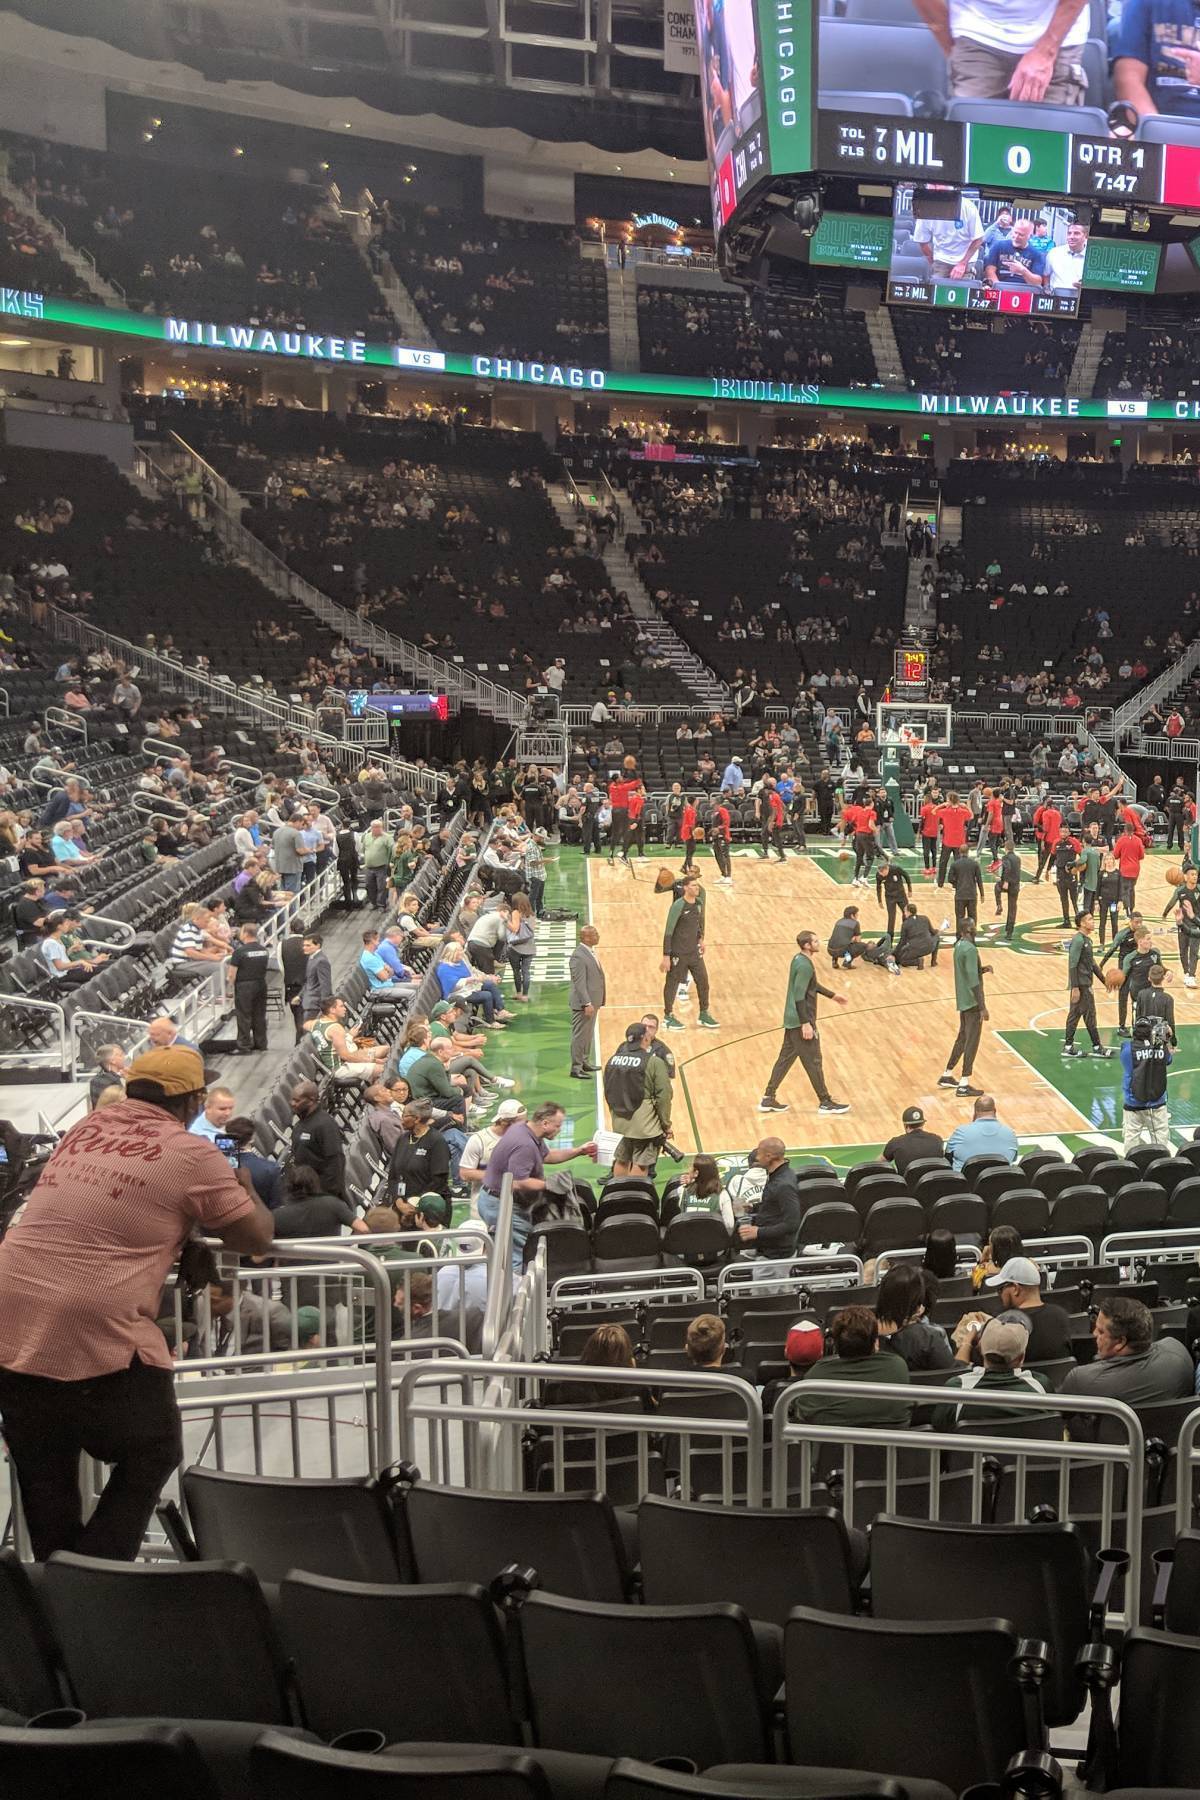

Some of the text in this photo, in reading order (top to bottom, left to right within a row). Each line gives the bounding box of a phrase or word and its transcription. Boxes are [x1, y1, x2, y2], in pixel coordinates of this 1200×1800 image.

[841, 127, 887, 143] TOL 7
[841, 146, 887, 161] FLS 0
[896, 130, 944, 168] MIL
[1079, 143, 1145, 169] QTR 1
[1007, 146, 1032, 174] 0
[736, 150, 748, 189] CHI
[1094, 172, 1138, 193] 7:47
[912, 287, 928, 299] MIL
[948, 290, 956, 302] 0
[1011, 295, 1019, 307] 0
[972, 299, 990, 309] 7:47
[1038, 298, 1053, 310] CHI
[168, 318, 606, 389] MILWAUKEE VS CHICAGO
[712, 377, 819, 404] BULLS
[920, 395, 1080, 416] MILWAUKEE
[1119, 403, 1137, 413] VS
[905, 653, 925, 663] 7:47
[907, 663, 921, 679] 12
[610, 1055, 641, 1067] PHOTO
[1135, 1049, 1165, 1060] PHOTO
